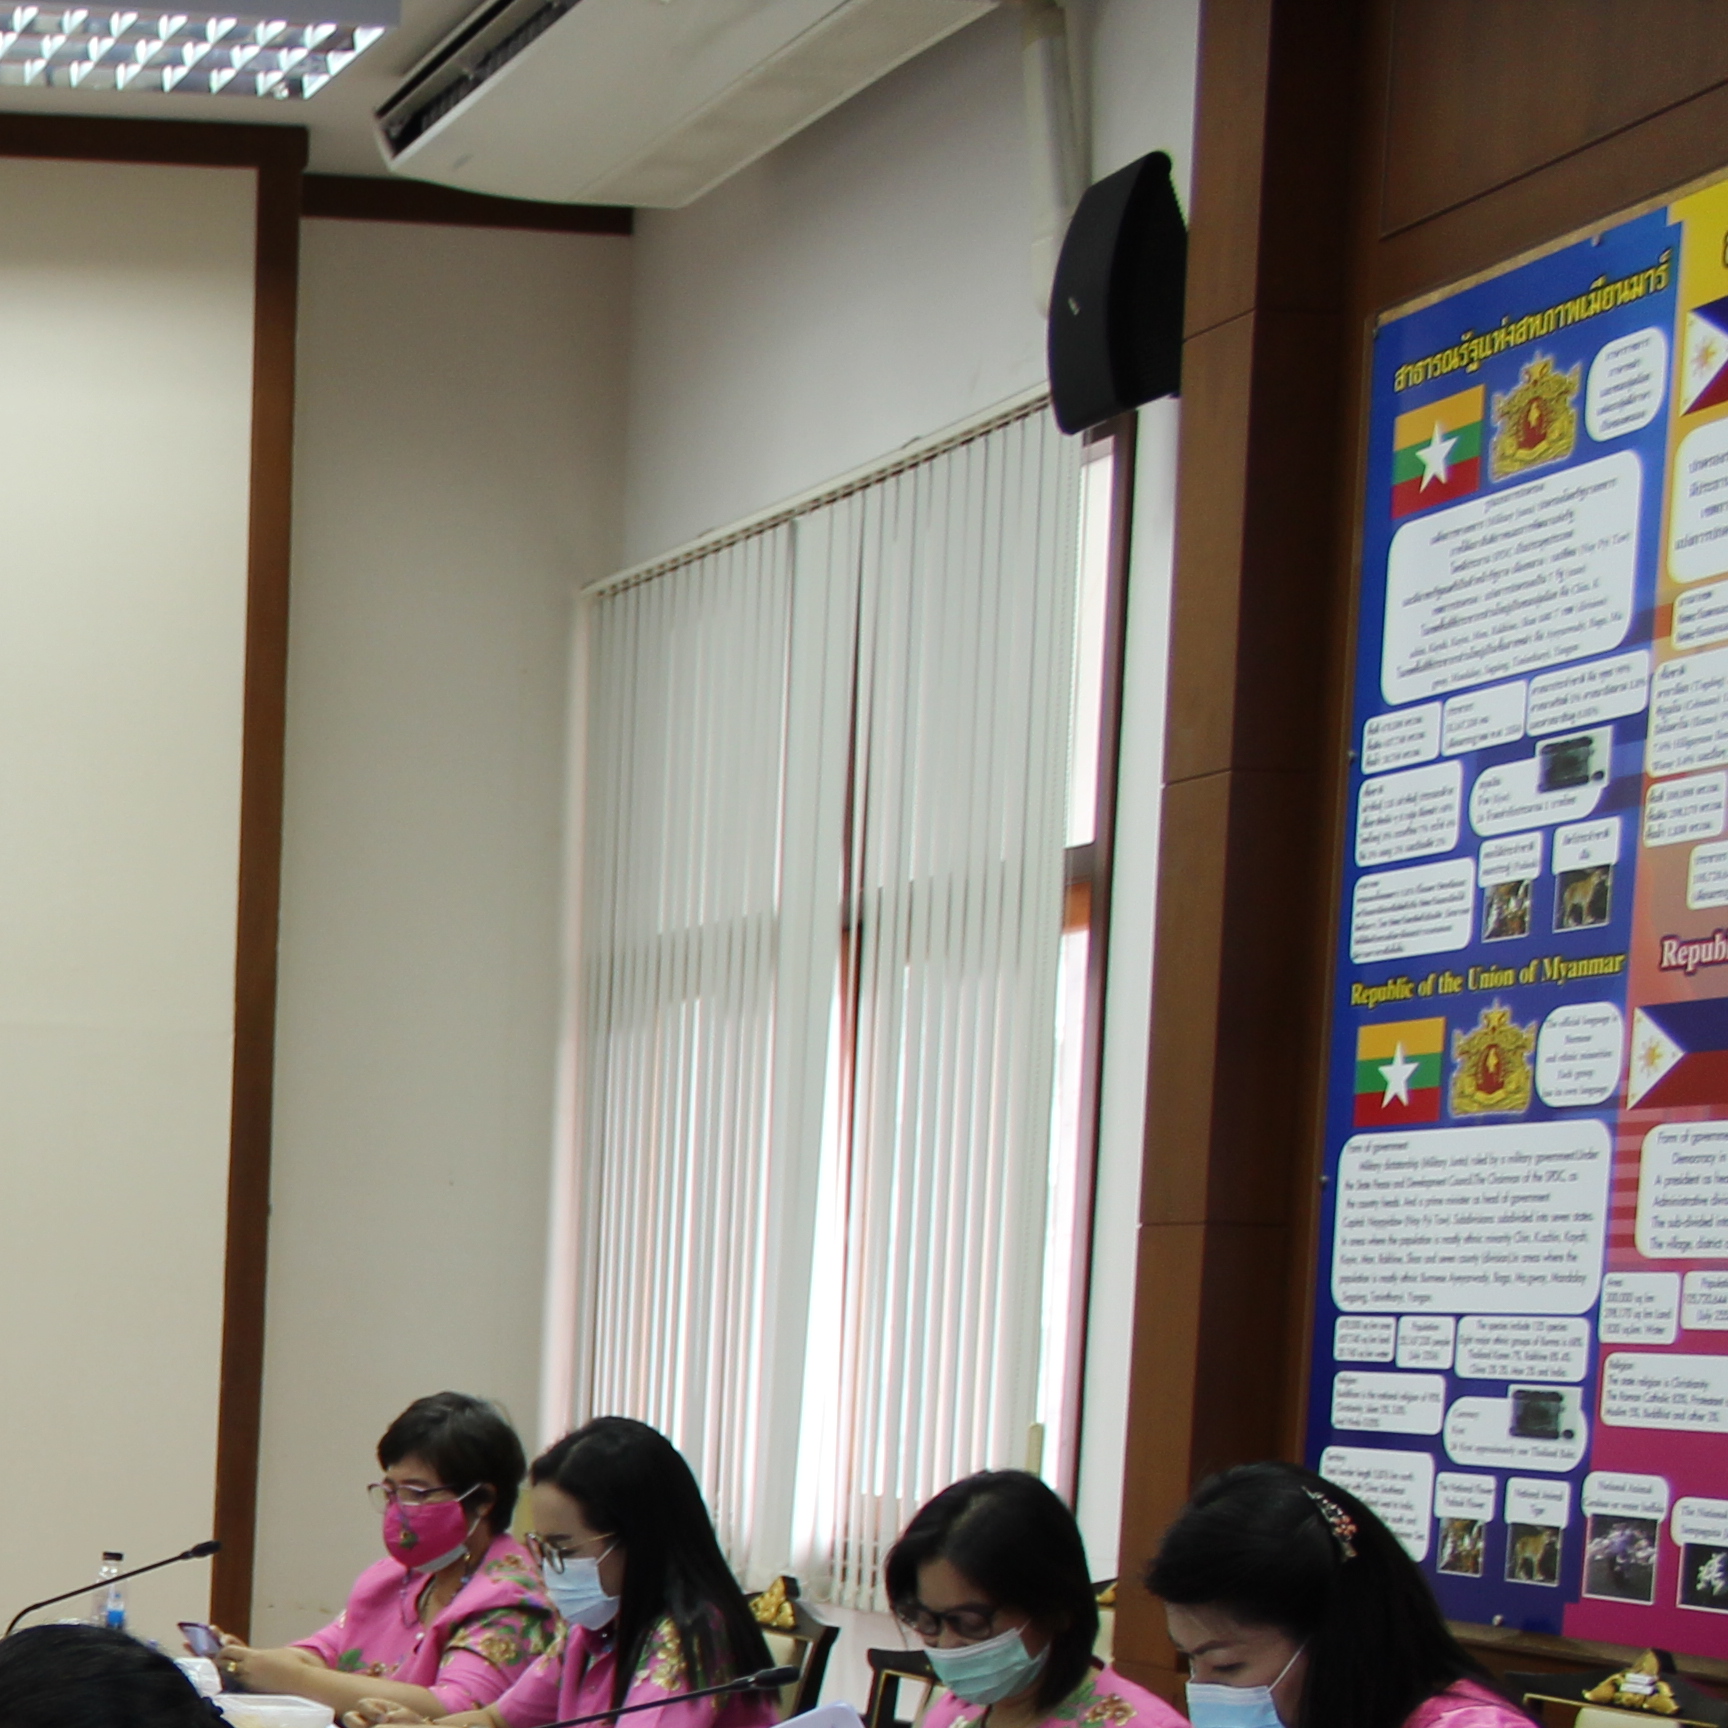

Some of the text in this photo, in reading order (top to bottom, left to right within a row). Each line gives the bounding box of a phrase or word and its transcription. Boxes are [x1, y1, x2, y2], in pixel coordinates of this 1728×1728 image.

[1350, 953, 1626, 1008] Republic of the Union of Myanmar
